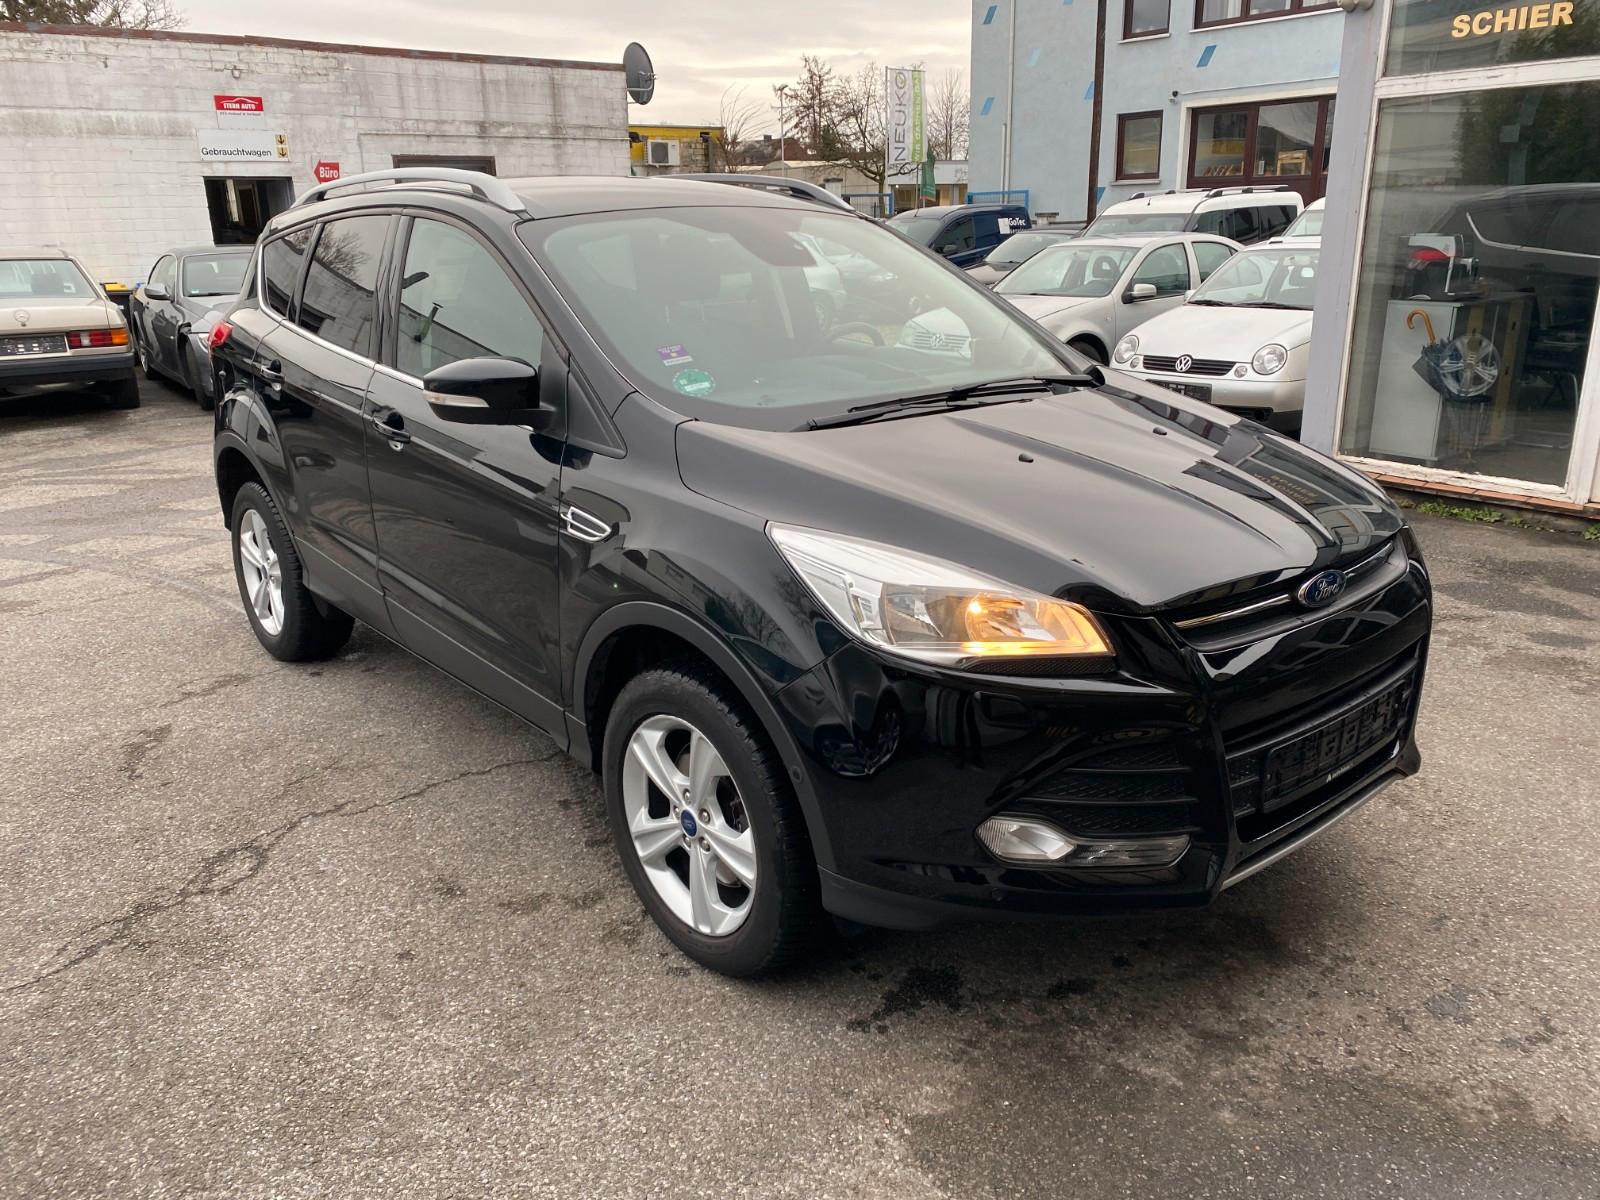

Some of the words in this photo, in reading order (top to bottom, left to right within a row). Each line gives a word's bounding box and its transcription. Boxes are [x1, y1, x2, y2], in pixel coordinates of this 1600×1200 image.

[1451, 1, 1574, 38] SCHIER
[894, 72, 906, 162] NEUKO
[201, 147, 272, 157] Gebrauchtwagen
[319, 166, 338, 179] Büro
